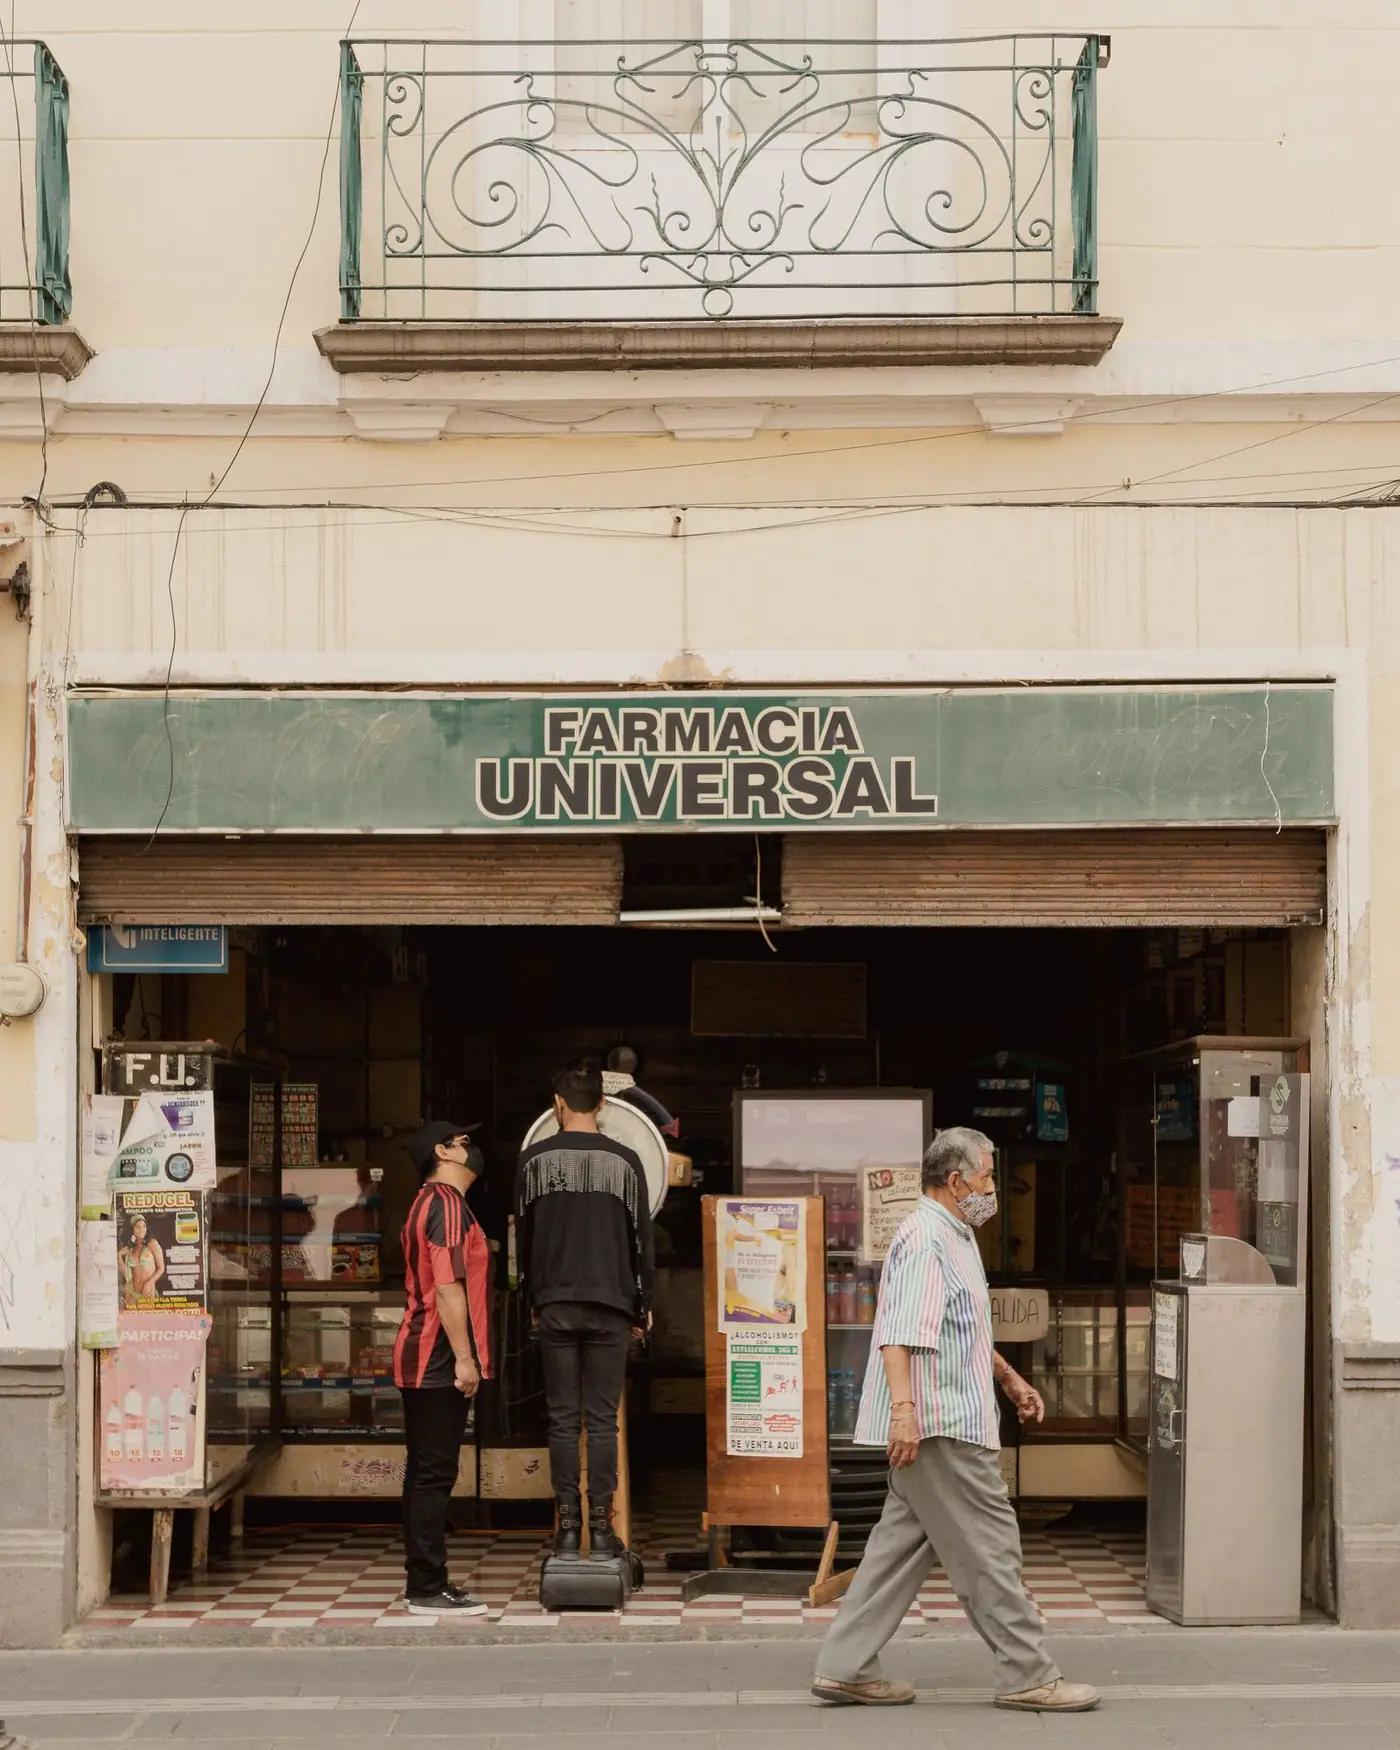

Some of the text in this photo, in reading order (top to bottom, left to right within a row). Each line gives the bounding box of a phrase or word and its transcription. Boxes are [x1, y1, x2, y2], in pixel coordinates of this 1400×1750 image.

[543, 706, 865, 756] FARMACIA
[474, 756, 939, 821] UNIVERSAL
[140, 927, 219, 941] INTELIGENTE
[126, 1052, 196, 1087] F.U.
[121, 1146, 153, 1157] AMPOO
[867, 1169, 894, 1191] NO
[123, 1191, 195, 1209] REDUGEL
[739, 1204, 766, 1215] Super
[990, 1296, 1039, 1325] ALIDA
[120, 1329, 203, 1342] PARTICIPA!
[730, 1331, 799, 1340] ¿ALCOHOLISMO?
[731, 1439, 799, 1450] DE VENTA AQUI
